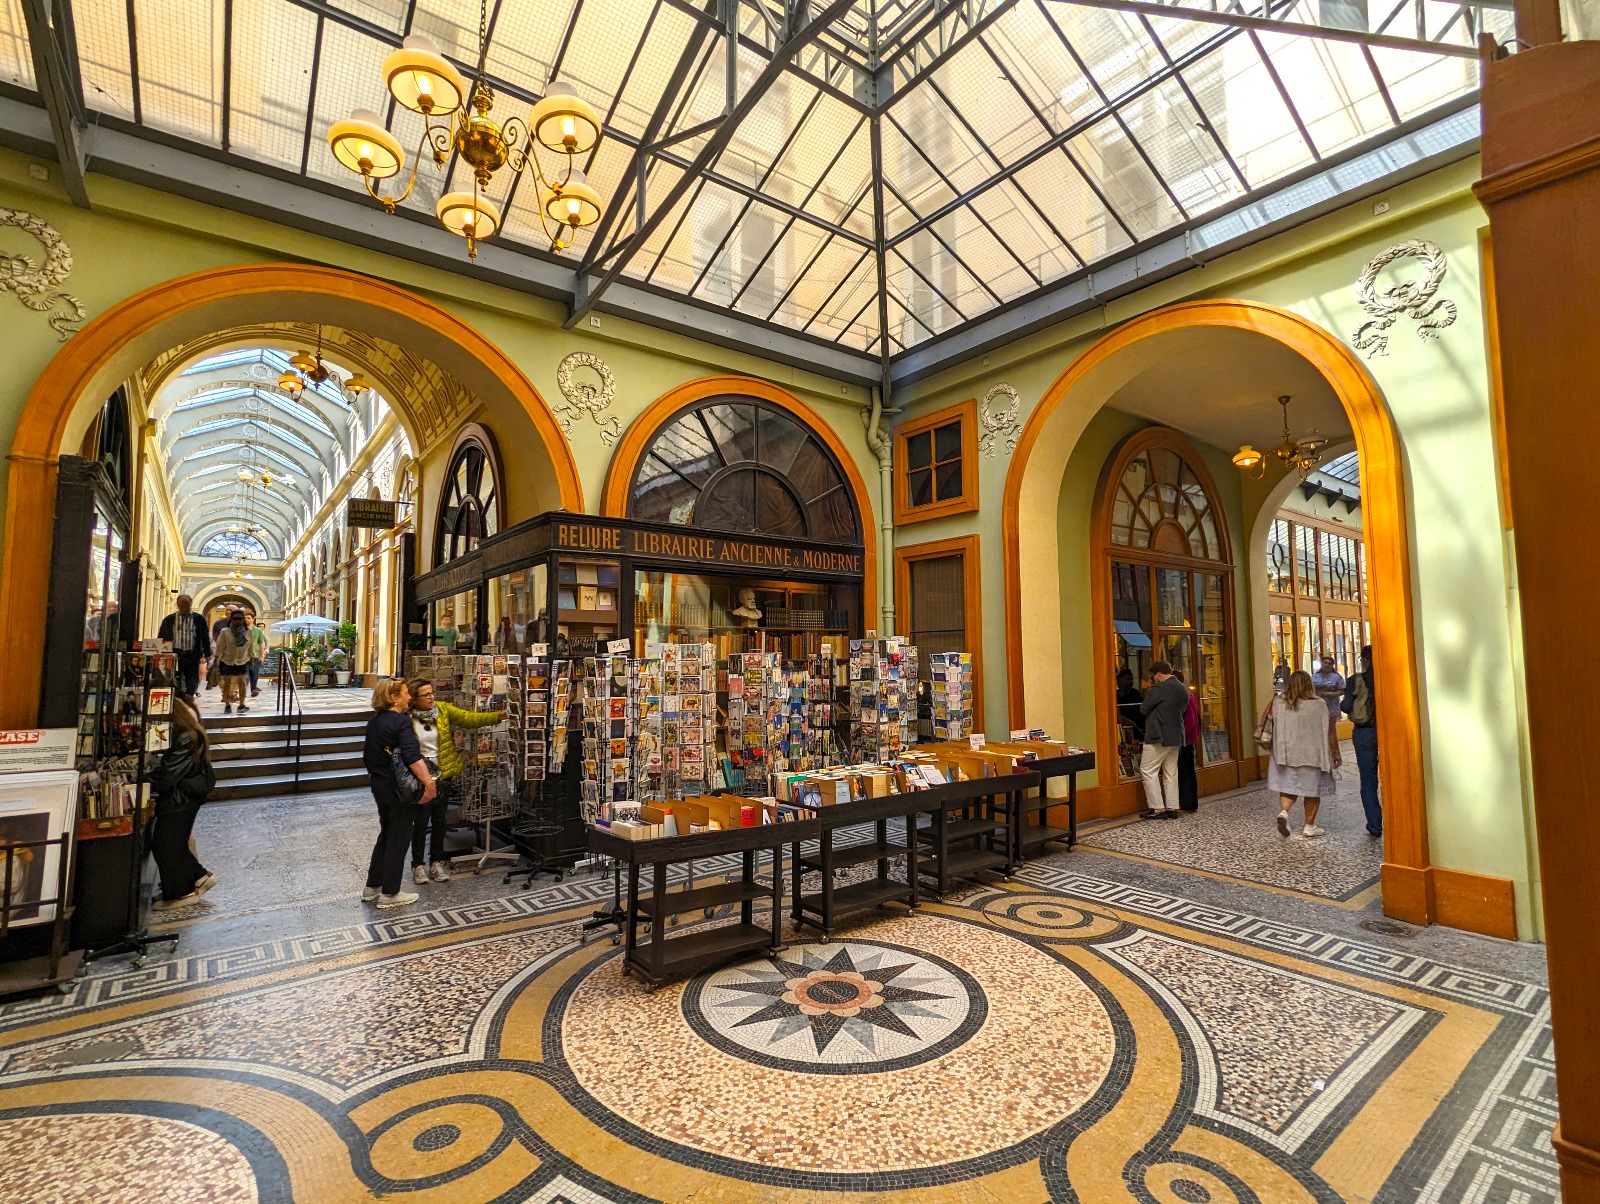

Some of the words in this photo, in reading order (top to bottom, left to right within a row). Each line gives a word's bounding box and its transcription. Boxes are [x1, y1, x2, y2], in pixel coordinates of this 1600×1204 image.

[350, 502, 394, 514] LIBRAIRIE
[350, 512, 394, 520] ANCIENNE
[558, 524, 621, 550] RELIURE
[634, 531, 715, 560] LIBRAIRIE
[719, 541, 792, 567] ANCIENNE
[793, 555, 800, 567] &
[803, 550, 860, 573] MODERNE
